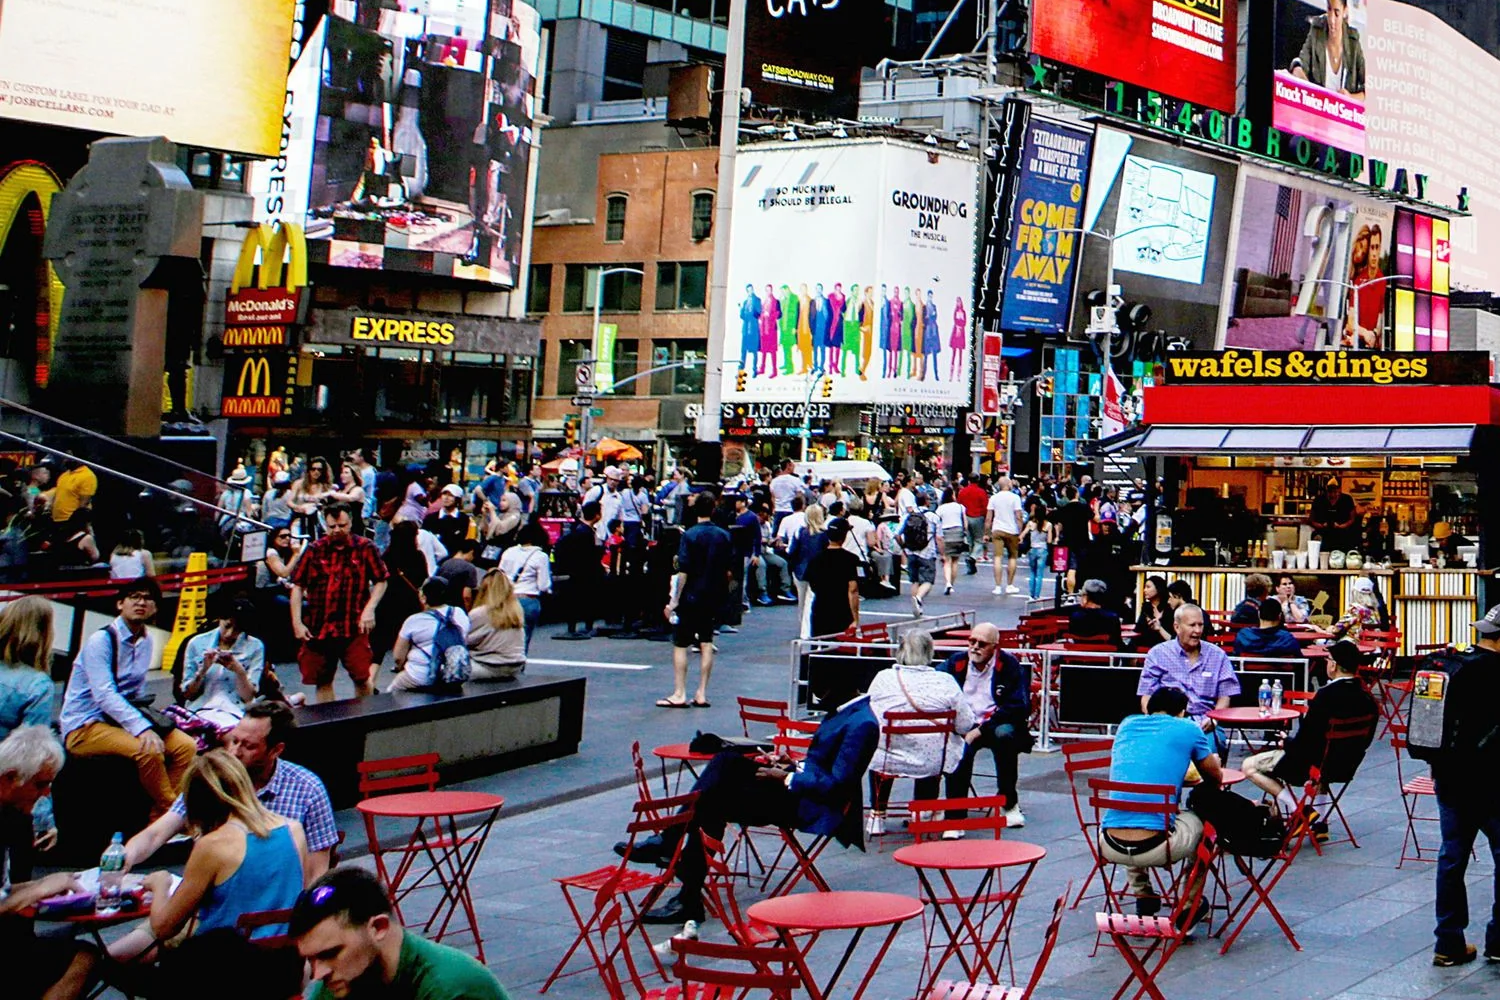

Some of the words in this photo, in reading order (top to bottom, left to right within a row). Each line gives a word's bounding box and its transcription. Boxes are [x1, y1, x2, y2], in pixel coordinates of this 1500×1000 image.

[1383, 18, 1426, 42] BELIEVE
[761, 63, 834, 85] CATSBROADWAY.COM
[1376, 57, 1413, 75] WHAT
[1366, 75, 1420, 97] SUPPORT
[1275, 80, 1302, 103] Knock
[1301, 88, 1324, 112] Twice
[1323, 99, 1340, 118] And
[1339, 105, 1353, 122] See
[1377, 96, 1402, 113] THE
[1366, 115, 1399, 133] YOUR
[1106, 81, 1222, 139] 1540
[1237, 116, 1430, 200] BROADWAY
[1368, 136, 1402, 154] WITH
[776, 187, 788, 196] SO
[792, 185, 816, 195] MUCH
[819, 184, 836, 194] FUN
[758, 199, 766, 208] IT
[769, 197, 802, 207] SHOULD
[804, 196, 816, 206] BE
[818, 195, 852, 205] ILLEGAL
[892, 189, 968, 219] GROUNDHOG
[918, 211, 941, 230] DAY
[1020, 198, 1077, 229] COME
[910, 229, 921, 239] THE
[922, 230, 947, 243] MUSICAL
[1015, 224, 1074, 257] FROM
[1010, 251, 1071, 285] AWAY
[227, 298, 295, 312] McDonald's
[353, 316, 456, 345] EXPRESS
[1170, 350, 1283, 379] wafels
[1284, 351, 1316, 379] &
[1315, 352, 1428, 384] dinges
[747, 403, 830, 419] LUGGAGE
[873, 403, 905, 417] GIFTS
[911, 402, 958, 419] LUGGAGE
[757, 427, 782, 435] SONY
[924, 426, 942, 434] SONY
